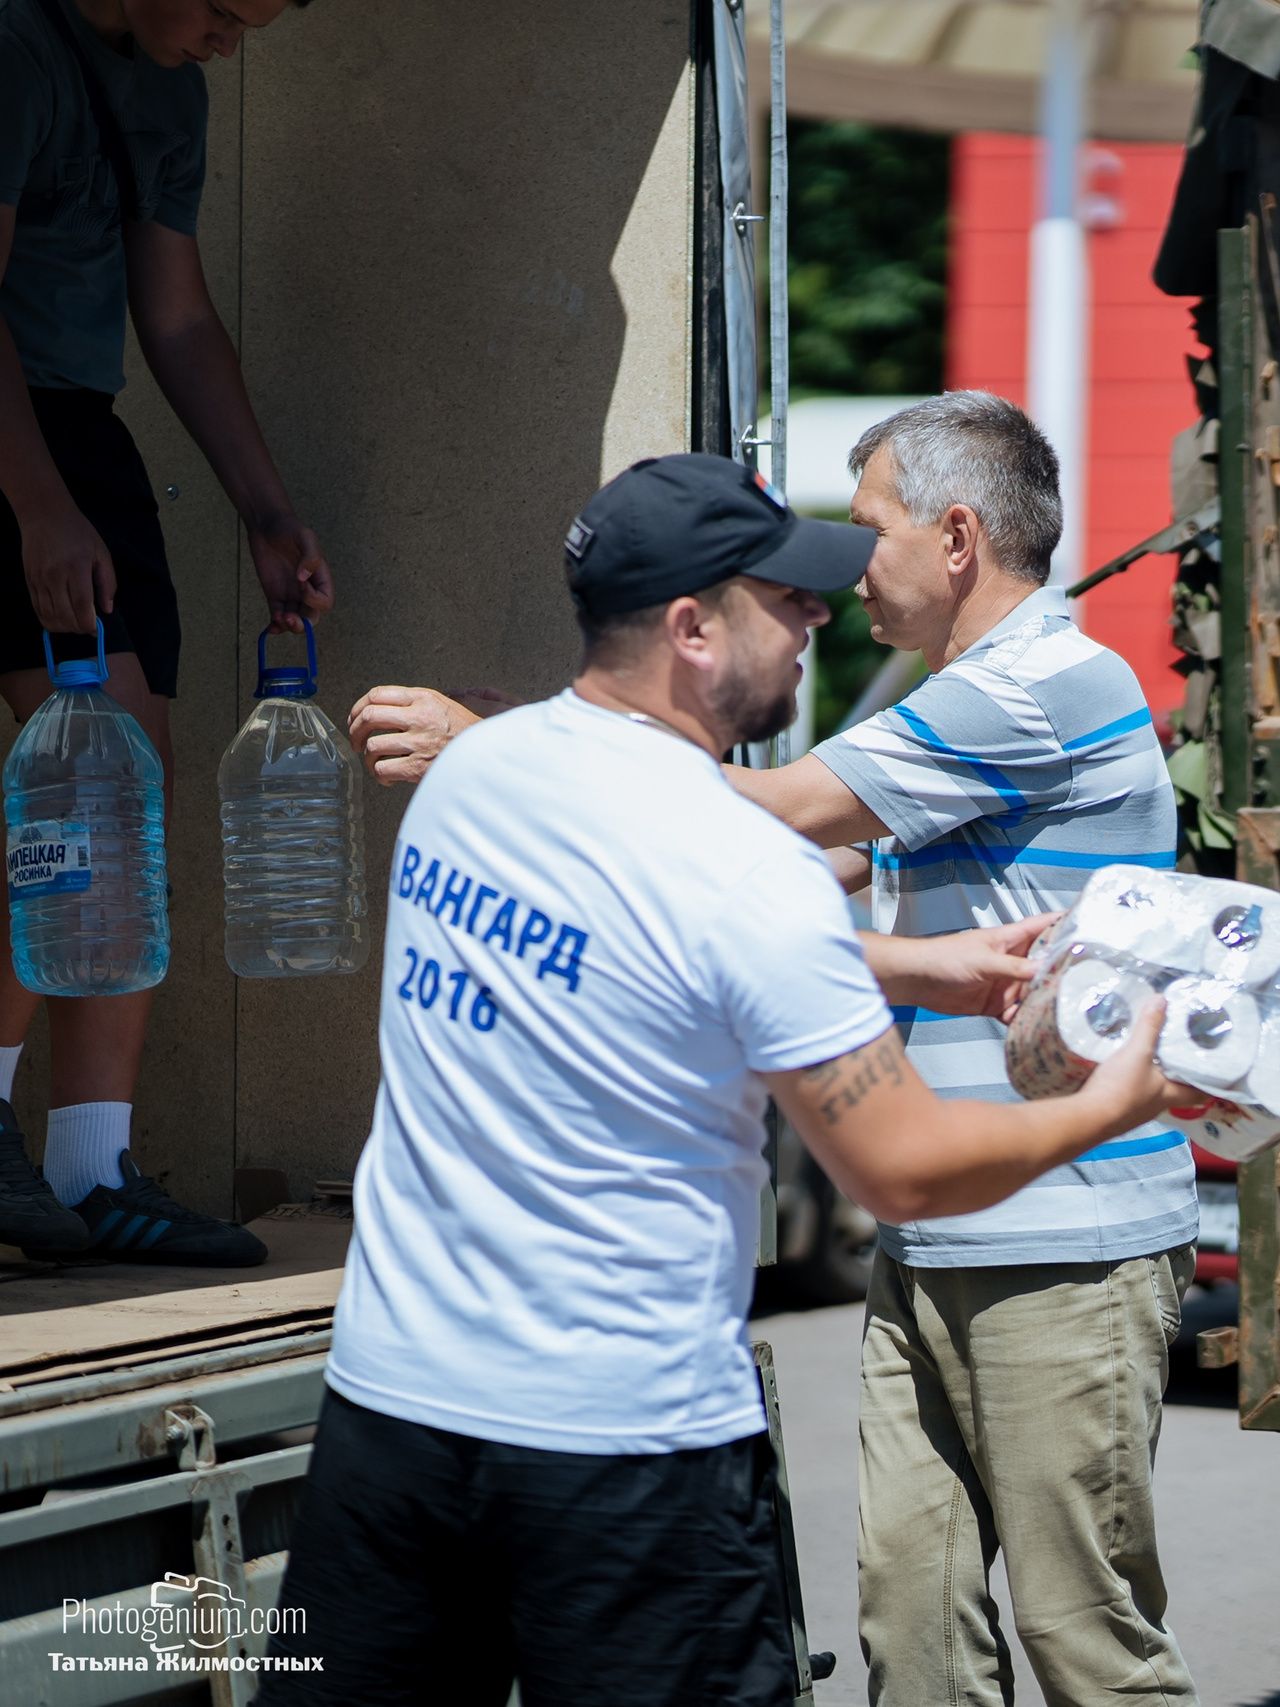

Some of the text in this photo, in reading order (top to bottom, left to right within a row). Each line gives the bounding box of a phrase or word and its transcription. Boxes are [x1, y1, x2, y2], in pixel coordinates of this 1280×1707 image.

[14, 865, 52, 883] РОСИНКА
[394, 841, 589, 994] ВАНГАРД
[399, 947, 499, 1032] 2016
